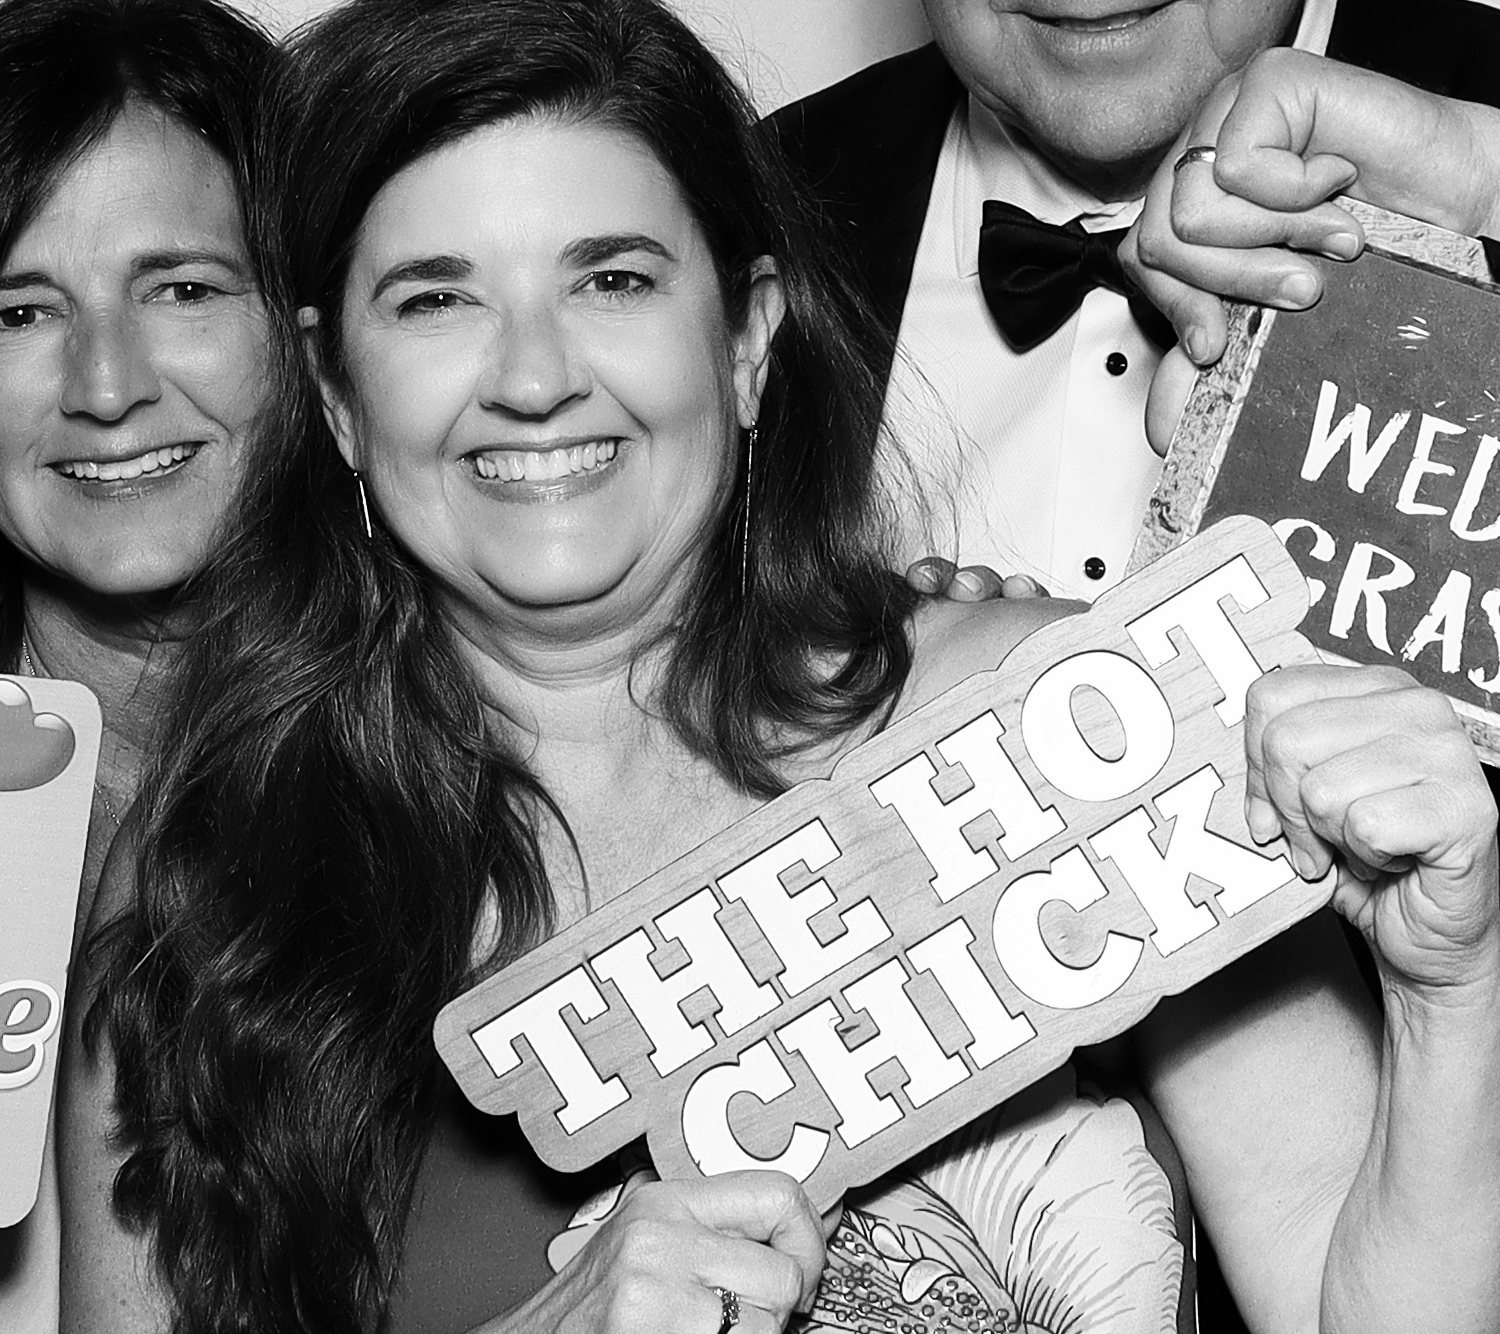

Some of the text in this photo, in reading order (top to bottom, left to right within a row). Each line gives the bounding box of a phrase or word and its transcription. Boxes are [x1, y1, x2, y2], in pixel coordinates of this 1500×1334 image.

[469, 553, 1283, 1136] THE HOT
[680, 762, 1298, 1179] CHICK
